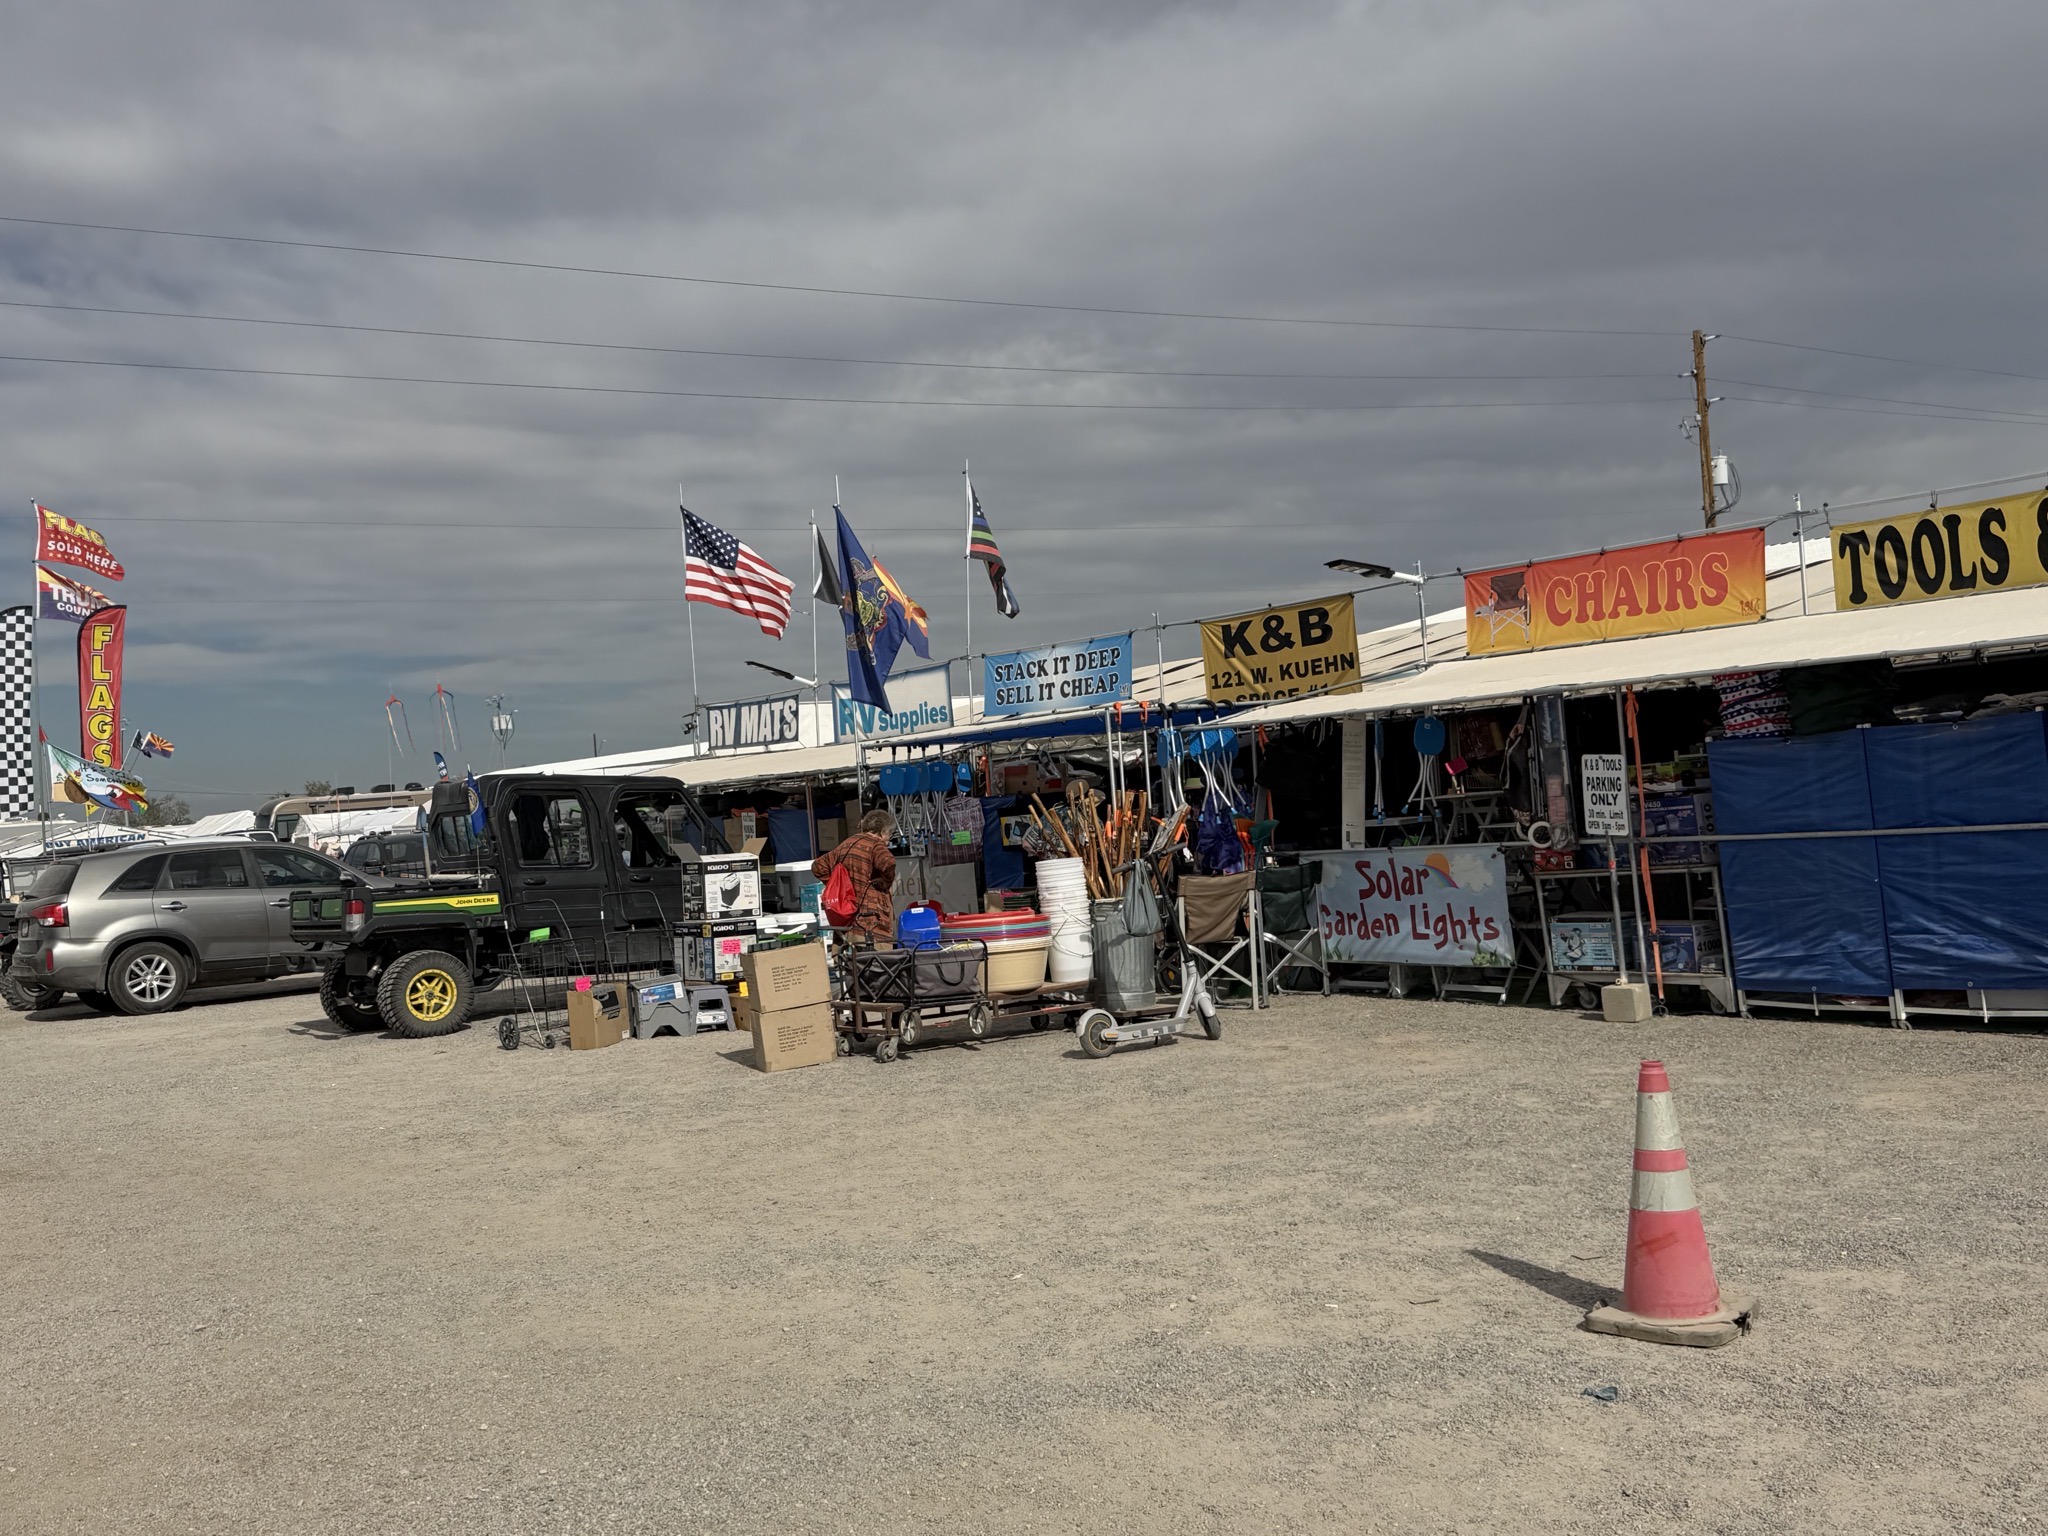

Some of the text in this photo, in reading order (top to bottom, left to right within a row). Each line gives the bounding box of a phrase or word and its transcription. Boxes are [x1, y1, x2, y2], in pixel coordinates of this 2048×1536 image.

[47, 540, 119, 570] SOLD HERE
[1839, 507, 2010, 604] TOOLS
[48, 583, 110, 608] TRUM
[1544, 552, 1728, 627] CHAIRS
[57, 602, 95, 616] COUN
[1221, 606, 1334, 660] K&B
[994, 647, 1121, 683] STACK IT DEEP
[1211, 652, 1355, 690] 121 W. KUEHN
[86, 624, 114, 768] FLAGS
[996, 685, 1034, 706] SELL
[1038, 682, 1055, 702] IT
[1060, 672, 1120, 699] CHEAP
[709, 698, 798, 748] RV MATS
[838, 697, 876, 737] RV
[1584, 759, 1622, 771] K & B TOOLS
[1586, 776, 1622, 792] PARKING
[1590, 793, 1618, 806] ONLY
[1588, 809, 1594, 818] 30
[1609, 810, 1624, 819] Limit
[1588, 821, 1600, 830] OPEN
[1355, 857, 1430, 901] Solar
[1320, 902, 1501, 950] Garden Lights
